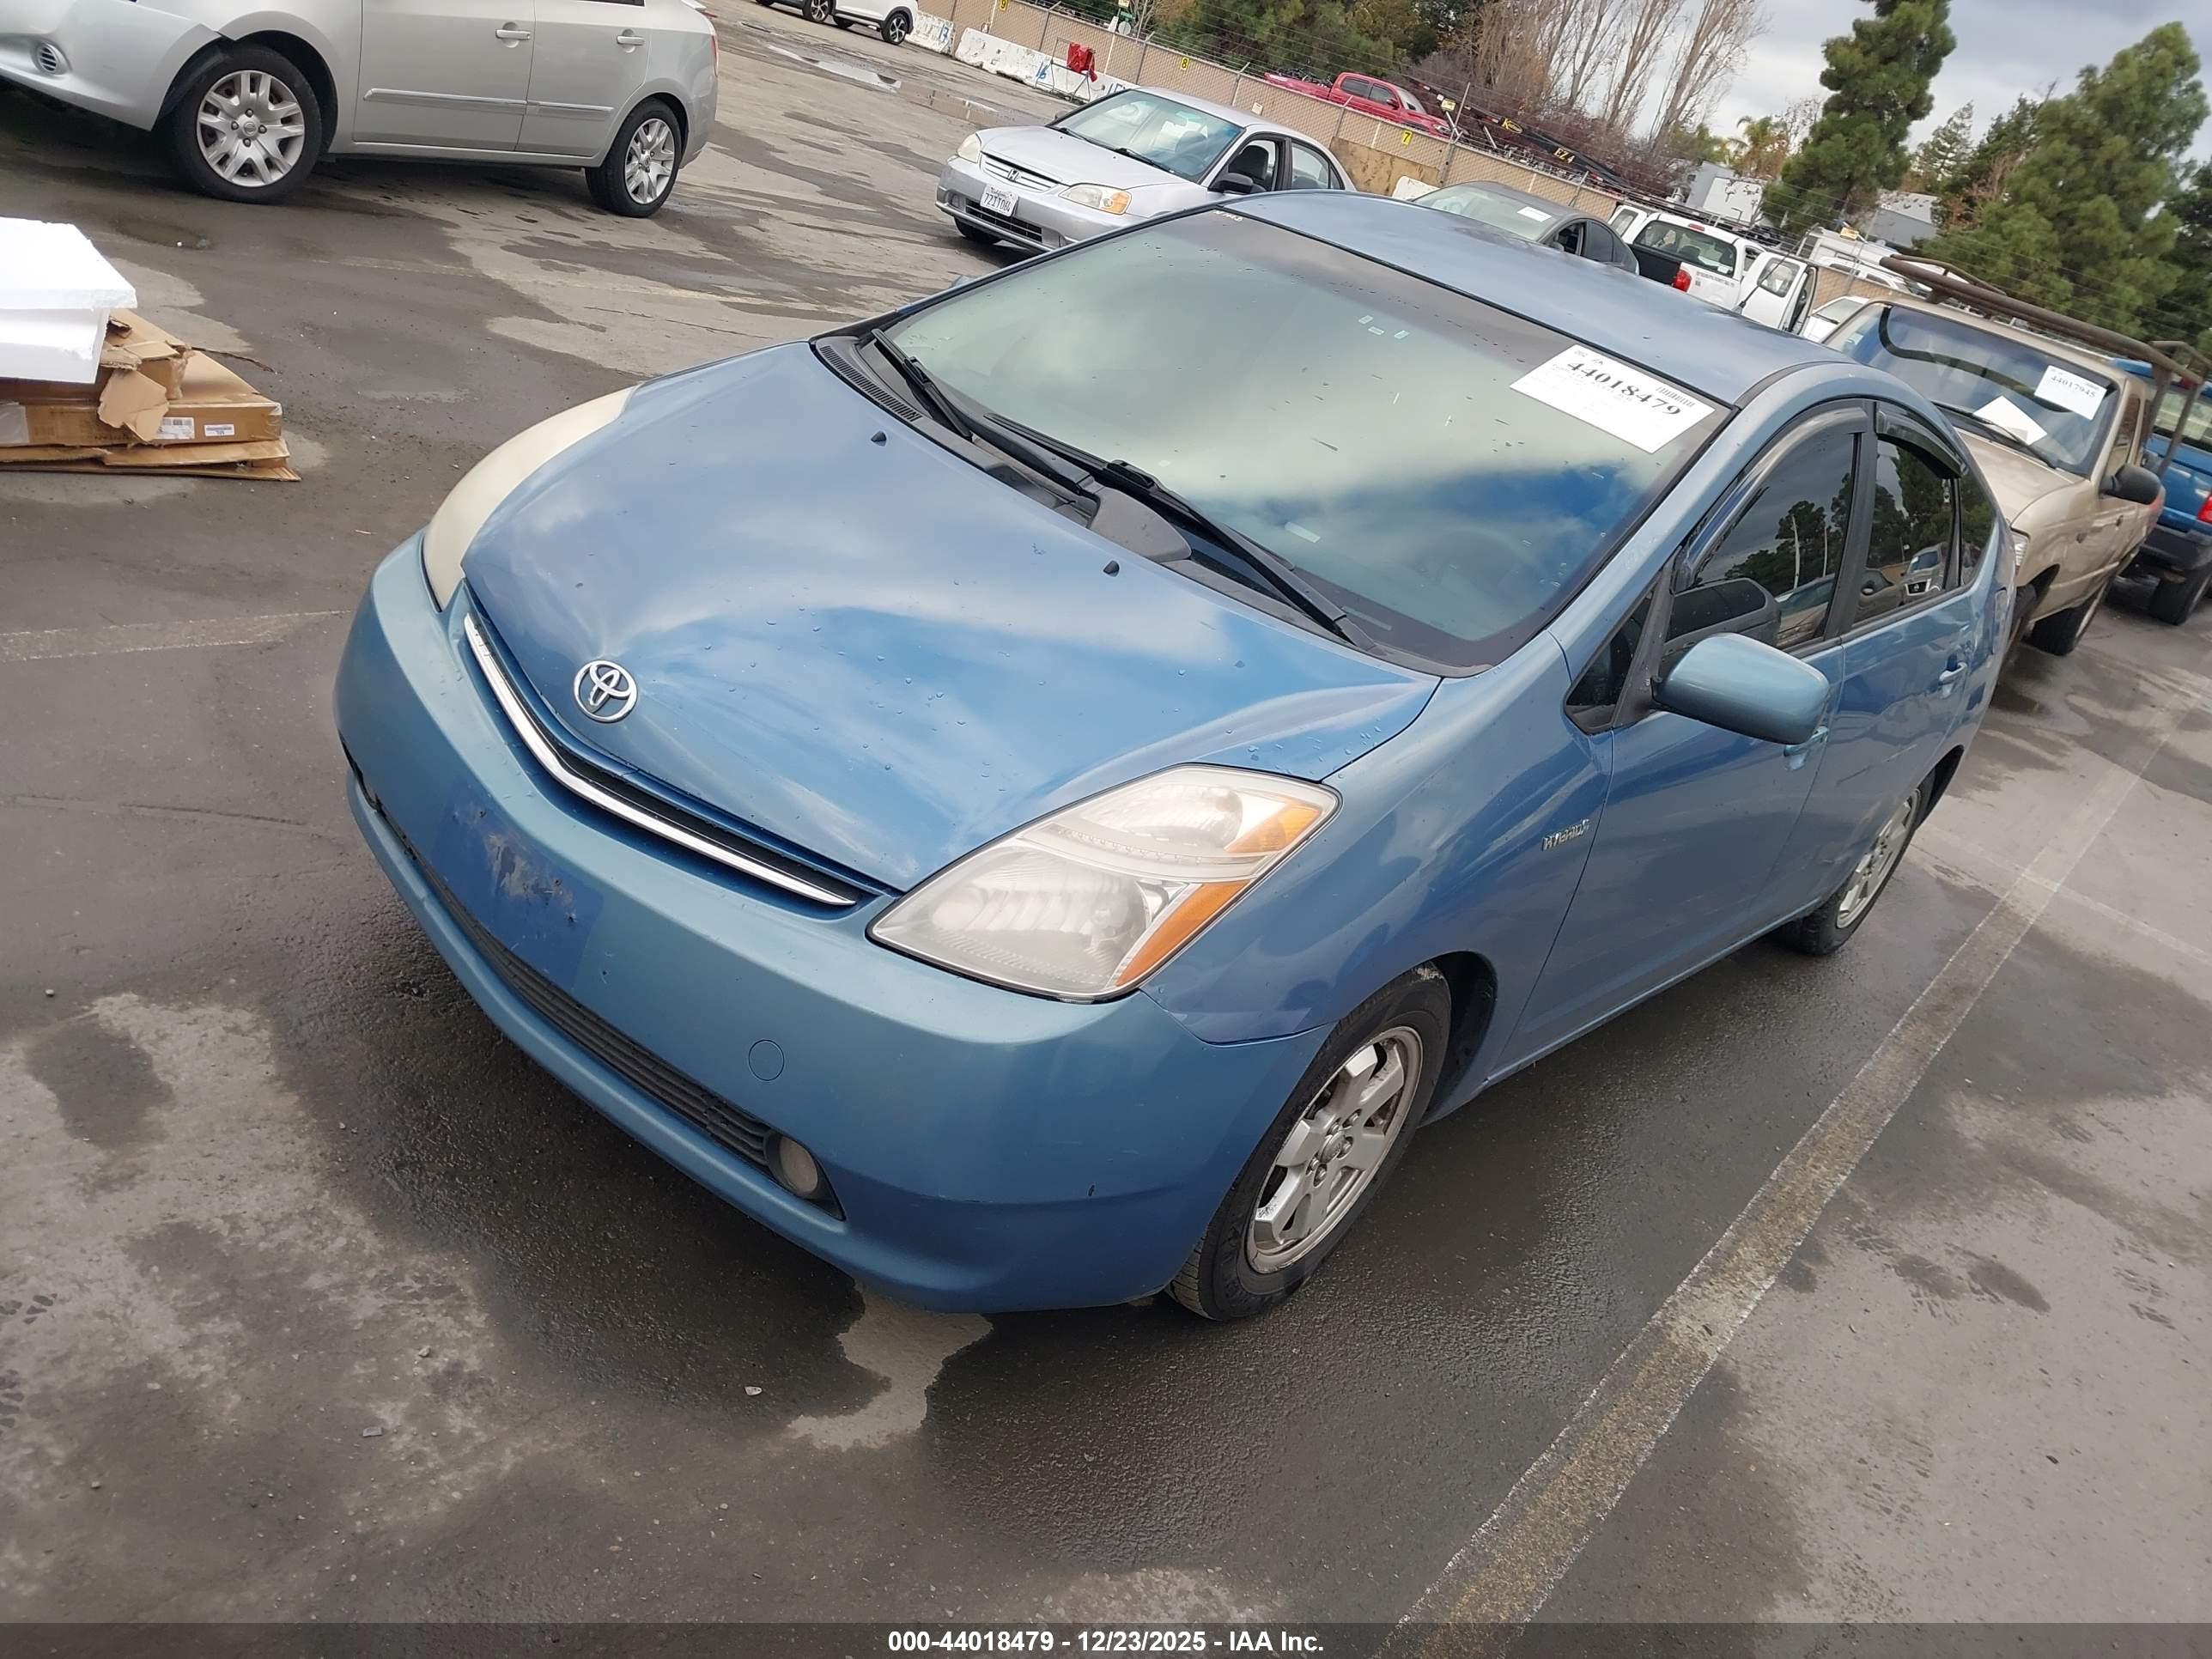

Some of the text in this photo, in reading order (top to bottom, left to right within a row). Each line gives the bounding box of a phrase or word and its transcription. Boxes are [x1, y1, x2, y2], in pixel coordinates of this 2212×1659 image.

[1181, 58, 1188, 69] 8
[1403, 131, 1411, 143] 7
[1566, 362, 1682, 416] 44018479
